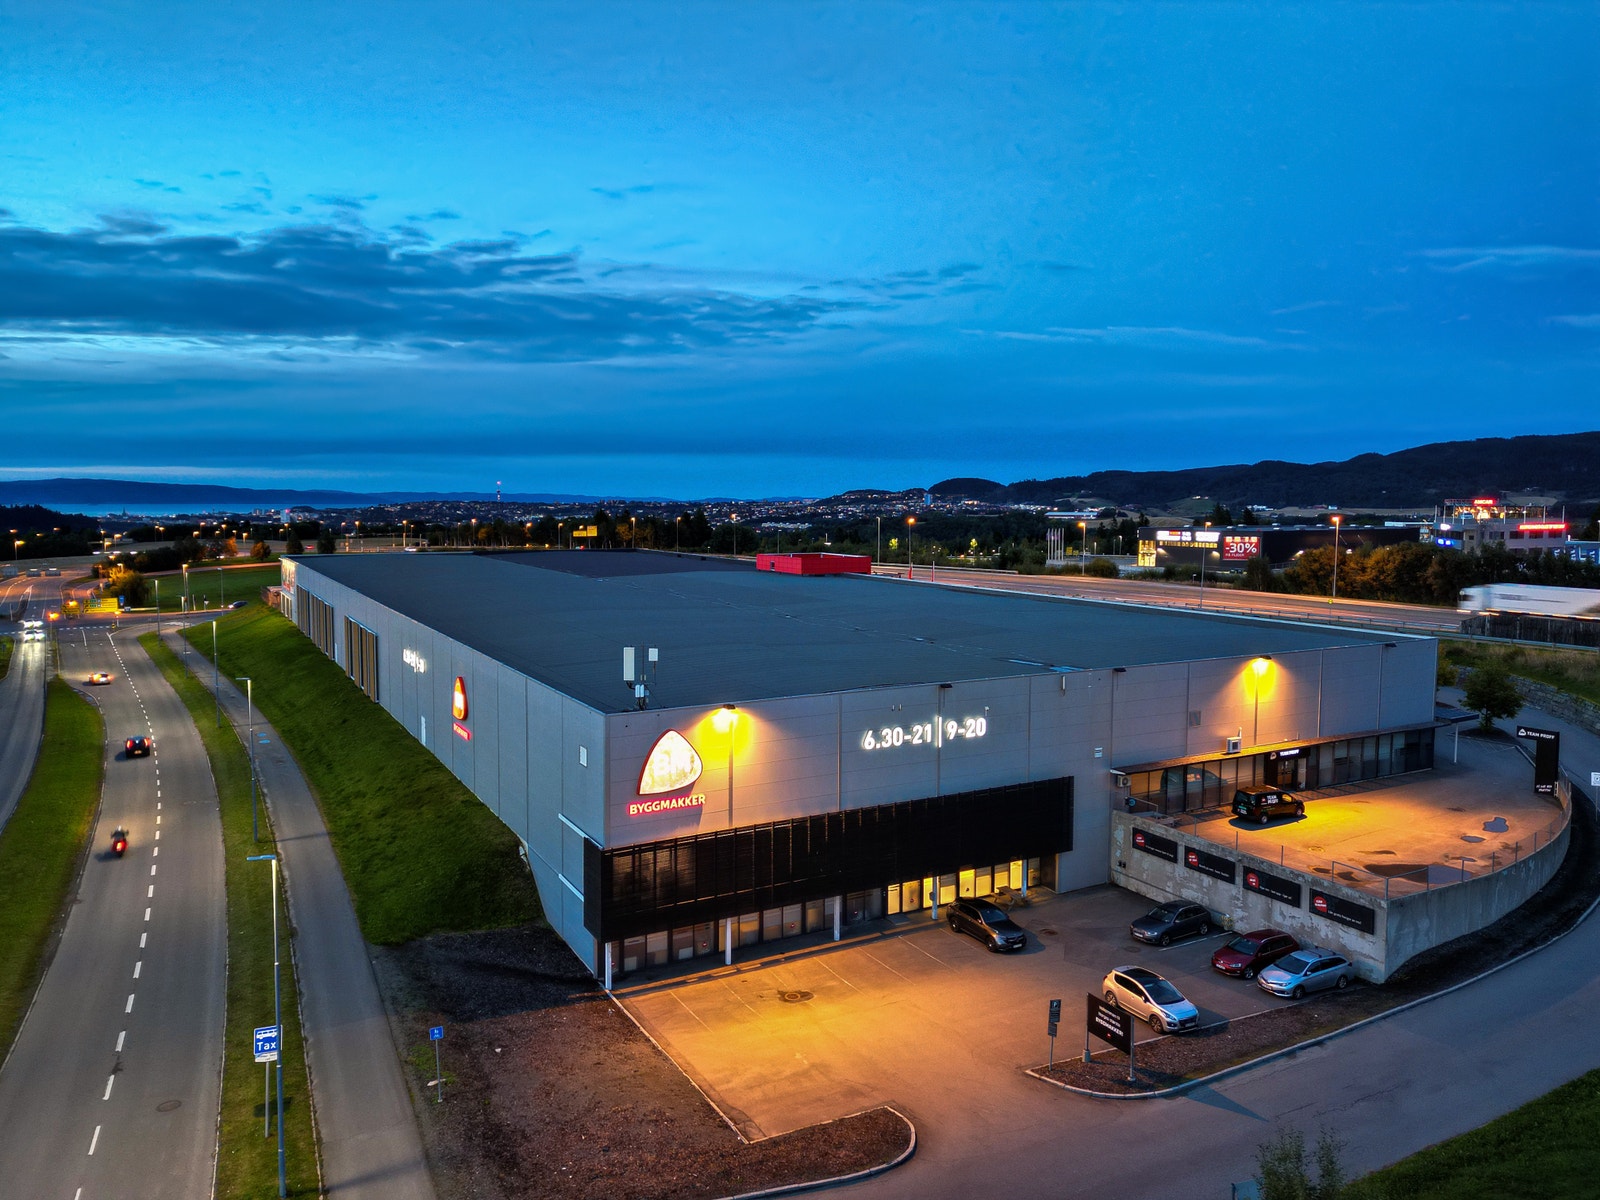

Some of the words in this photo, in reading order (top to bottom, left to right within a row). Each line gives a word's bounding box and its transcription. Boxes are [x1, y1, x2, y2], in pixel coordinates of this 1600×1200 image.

[1225, 542, 1257, 553] -30%
[862, 723, 932, 750] 6.30-21
[946, 717, 987, 740] 9-20
[629, 794, 706, 815] BYGGMAKKER
